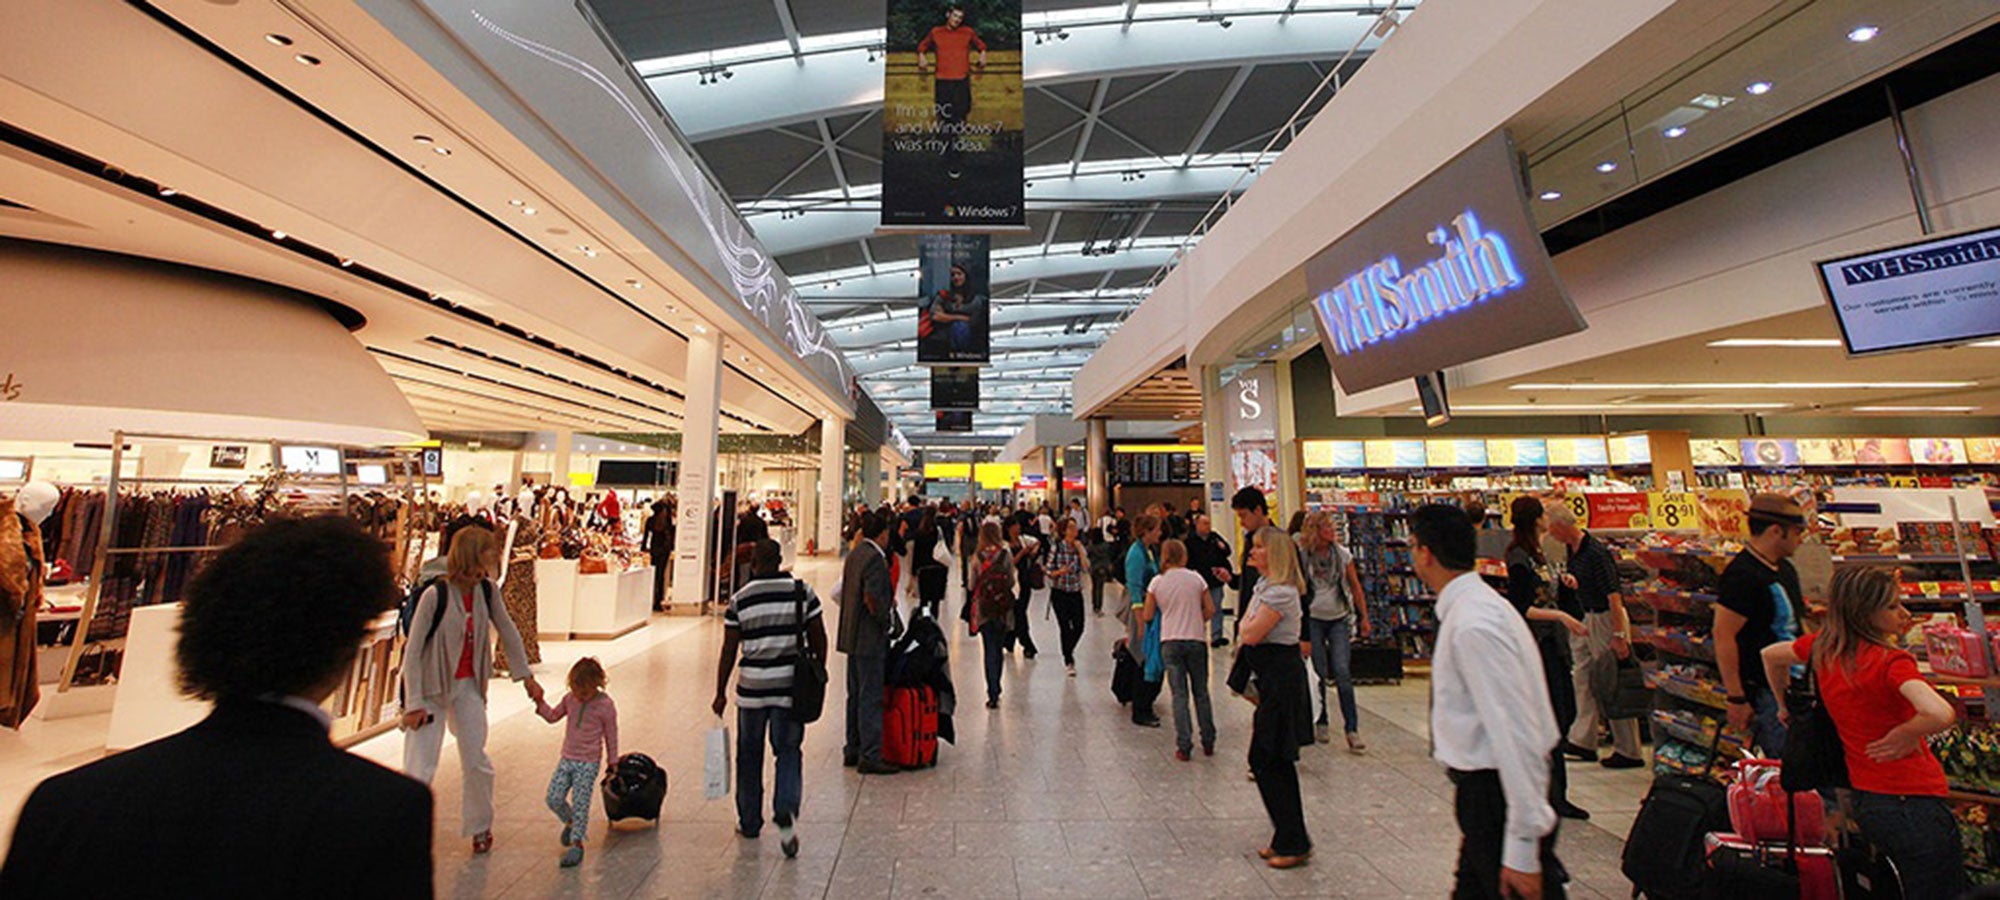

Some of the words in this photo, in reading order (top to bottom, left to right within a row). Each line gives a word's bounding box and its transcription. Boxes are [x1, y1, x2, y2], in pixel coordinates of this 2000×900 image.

[895, 103, 915, 117] I'm
[920, 108, 928, 118] a
[933, 103, 953, 118] PC
[895, 121, 923, 135] and
[927, 121, 993, 135] Windows
[995, 121, 1004, 134] 7
[894, 140, 922, 151] was
[926, 140, 949, 155] my
[953, 138, 986, 152] idea.
[957, 205, 1009, 217] Windows
[1011, 206, 1017, 217] 7
[1846, 241, 2000, 282] WHSmith
[1309, 208, 1521, 356] WHSmith
[1922, 290, 1940, 298] are
[1944, 281, 1996, 296] currently
[1874, 303, 1909, 314] served
[1913, 298, 1946, 308] within
[1663, 494, 1686, 503] SAVE
